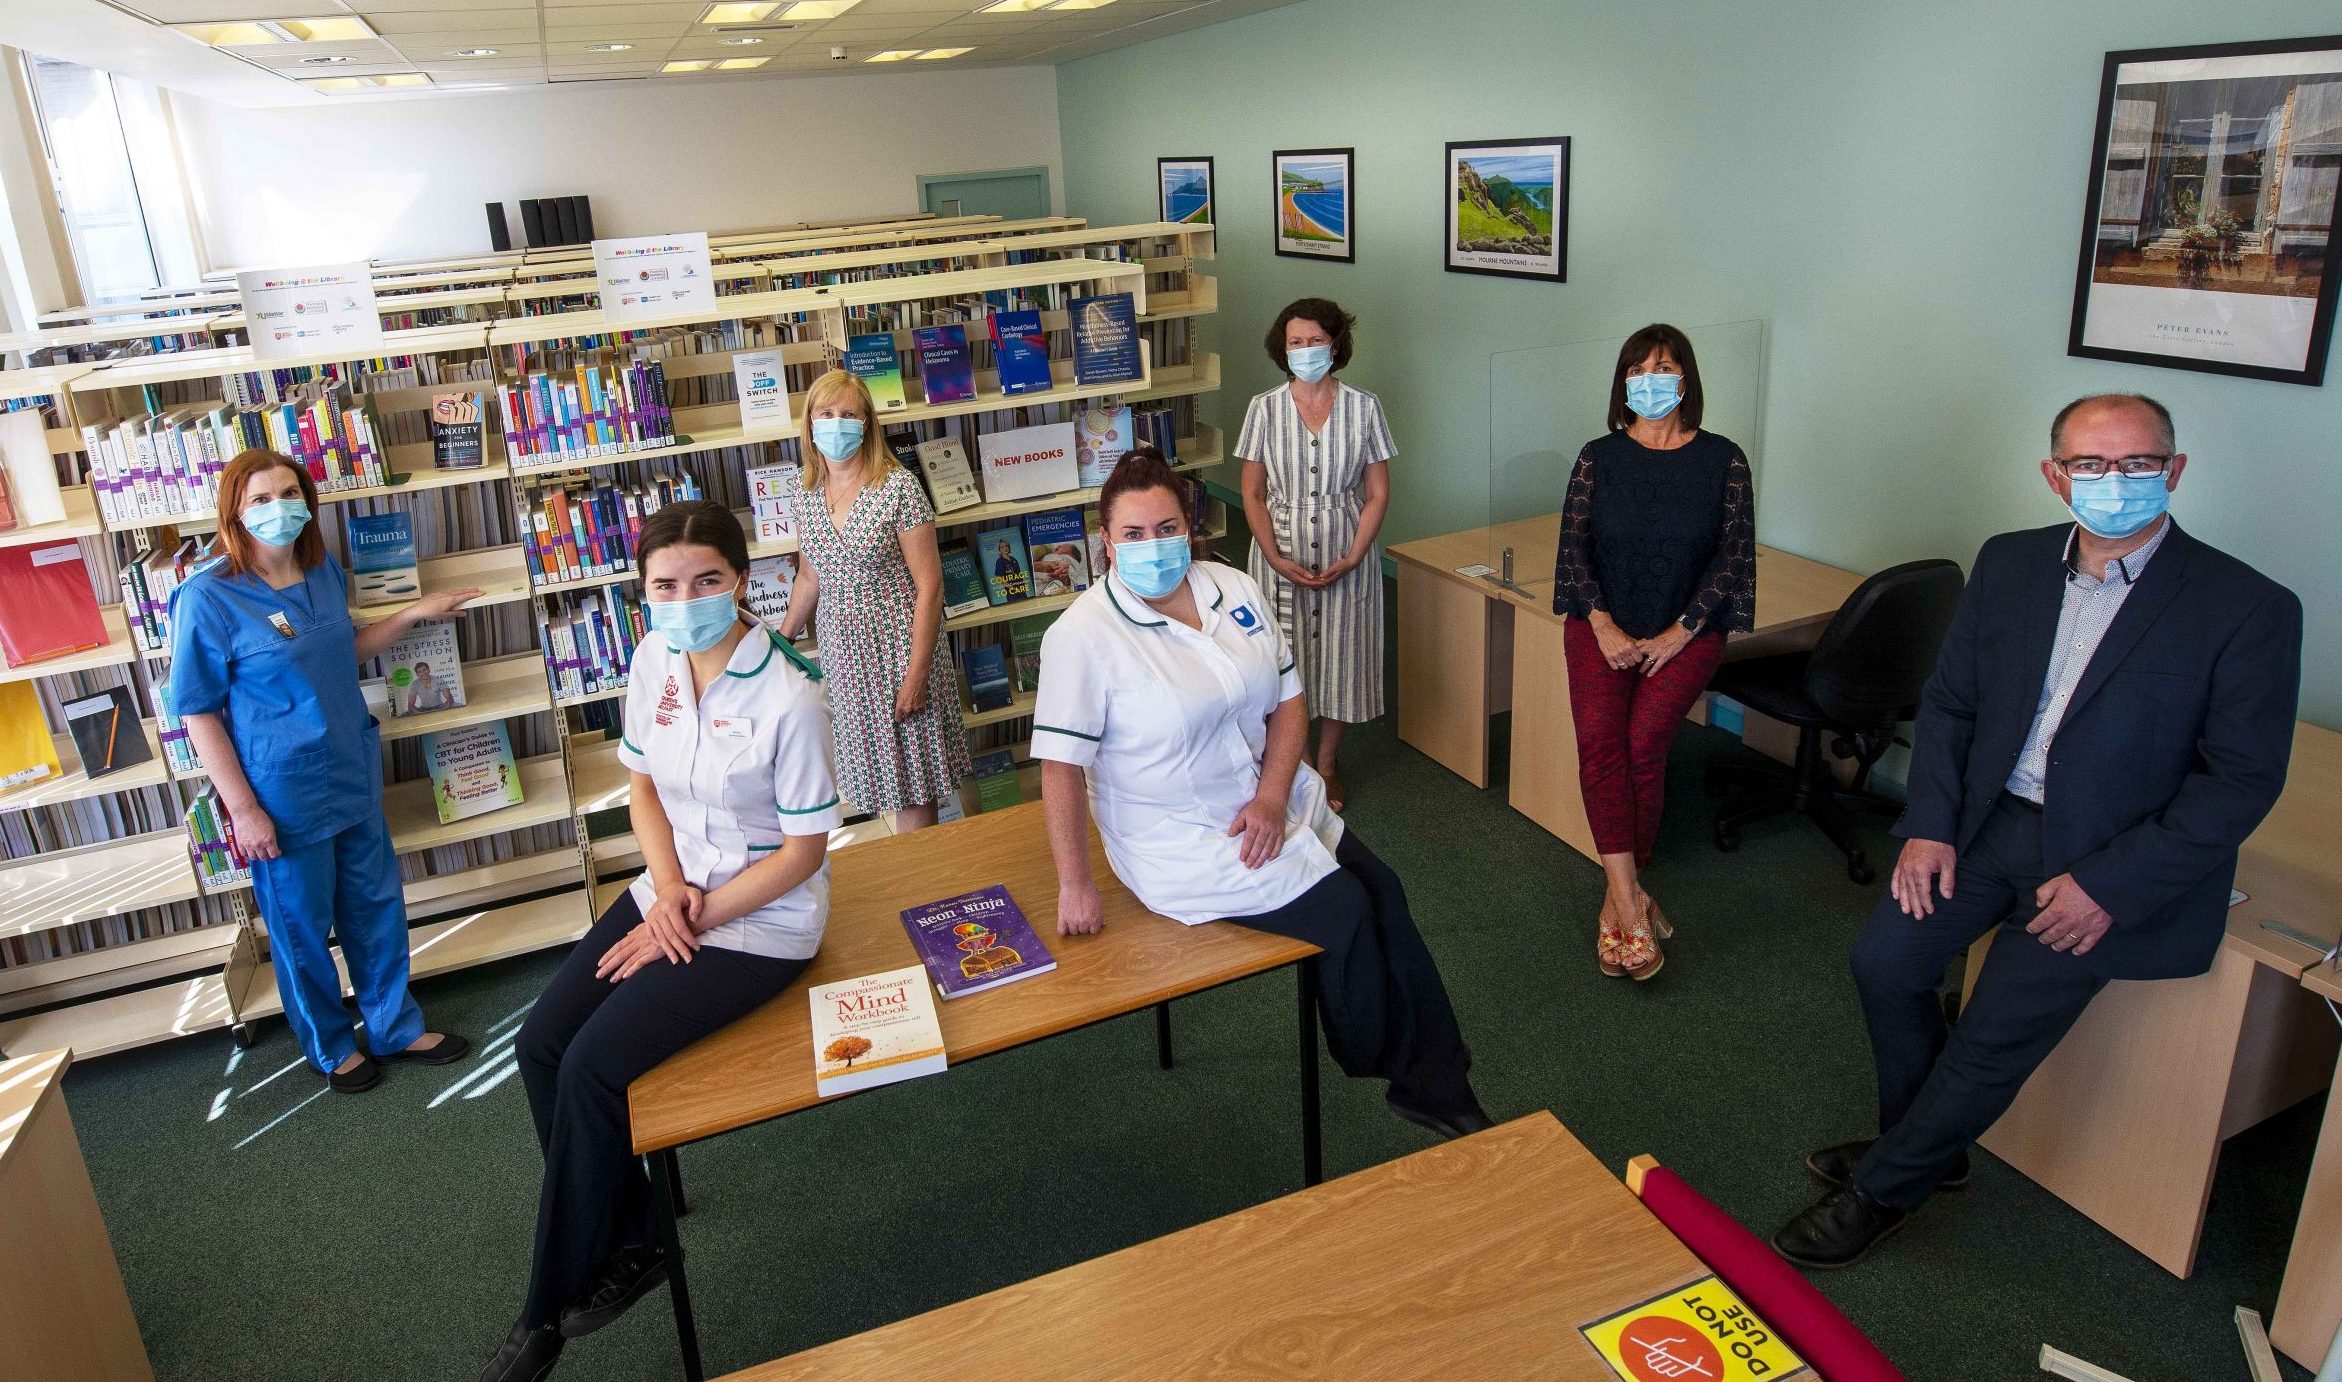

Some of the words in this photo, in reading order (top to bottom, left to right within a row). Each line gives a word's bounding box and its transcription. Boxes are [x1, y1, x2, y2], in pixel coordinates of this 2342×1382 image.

[1000, 325, 1023, 333] Case-Based
[1023, 323, 1038, 331] Clinical
[2157, 324, 2190, 333] PETER
[2196, 327, 2228, 336] EVANS
[1103, 334, 1128, 342] Behaviors
[849, 351, 881, 359] Introduction
[851, 356, 893, 365] Evidence-Based
[746, 387, 778, 397] SWITCH
[439, 426, 478, 436] ANXIETY
[439, 440, 479, 449] BEGINNERS
[924, 444, 940, 452] Good
[942, 440, 959, 448] Blood
[994, 455, 1021, 467] NEW
[1023, 448, 1064, 462] BOOKS
[769, 466, 793, 474] HANSON
[1031, 520, 1080, 532] EMERGENCIES
[357, 530, 408, 545] Trauma
[944, 564, 971, 575] PRIMARY
[955, 570, 971, 579] CARE
[990, 570, 1030, 585] COURAGE
[748, 580, 766, 591] The
[995, 589, 1008, 598] TO
[1009, 584, 1031, 595] CARE
[748, 590, 789, 604] indness
[390, 645, 409, 654] THE
[414, 638, 451, 650] STRESS
[391, 647, 452, 662] SOLUTION
[434, 749, 452, 759] CBT
[453, 746, 466, 755] for
[467, 738, 501, 751] Children
[442, 737, 470, 747] Clinician's
[437, 760, 447, 768] to
[447, 752, 475, 765] Young
[476, 746, 502, 758] Adults
[457, 770, 473, 779] Think
[473, 766, 491, 776] Good,
[456, 786, 481, 796] Thinking
[481, 781, 499, 790] Good,
[459, 792, 480, 801] Feeling
[480, 787, 498, 795] Better
[916, 909, 957, 928] Neon
[962, 898, 1006, 914] Ninja
[824, 978, 913, 1000] Compassionate
[858, 979, 878, 987] The
[835, 987, 907, 1016] Mind
[837, 1004, 909, 1024] Workbook
[829, 1029, 858, 1038] developing
[872, 1018, 910, 1029] compassionate
[1682, 1296, 1735, 1339] NOT
[1722, 1304, 1769, 1347] USE
[1730, 1340, 1771, 1376] DO
